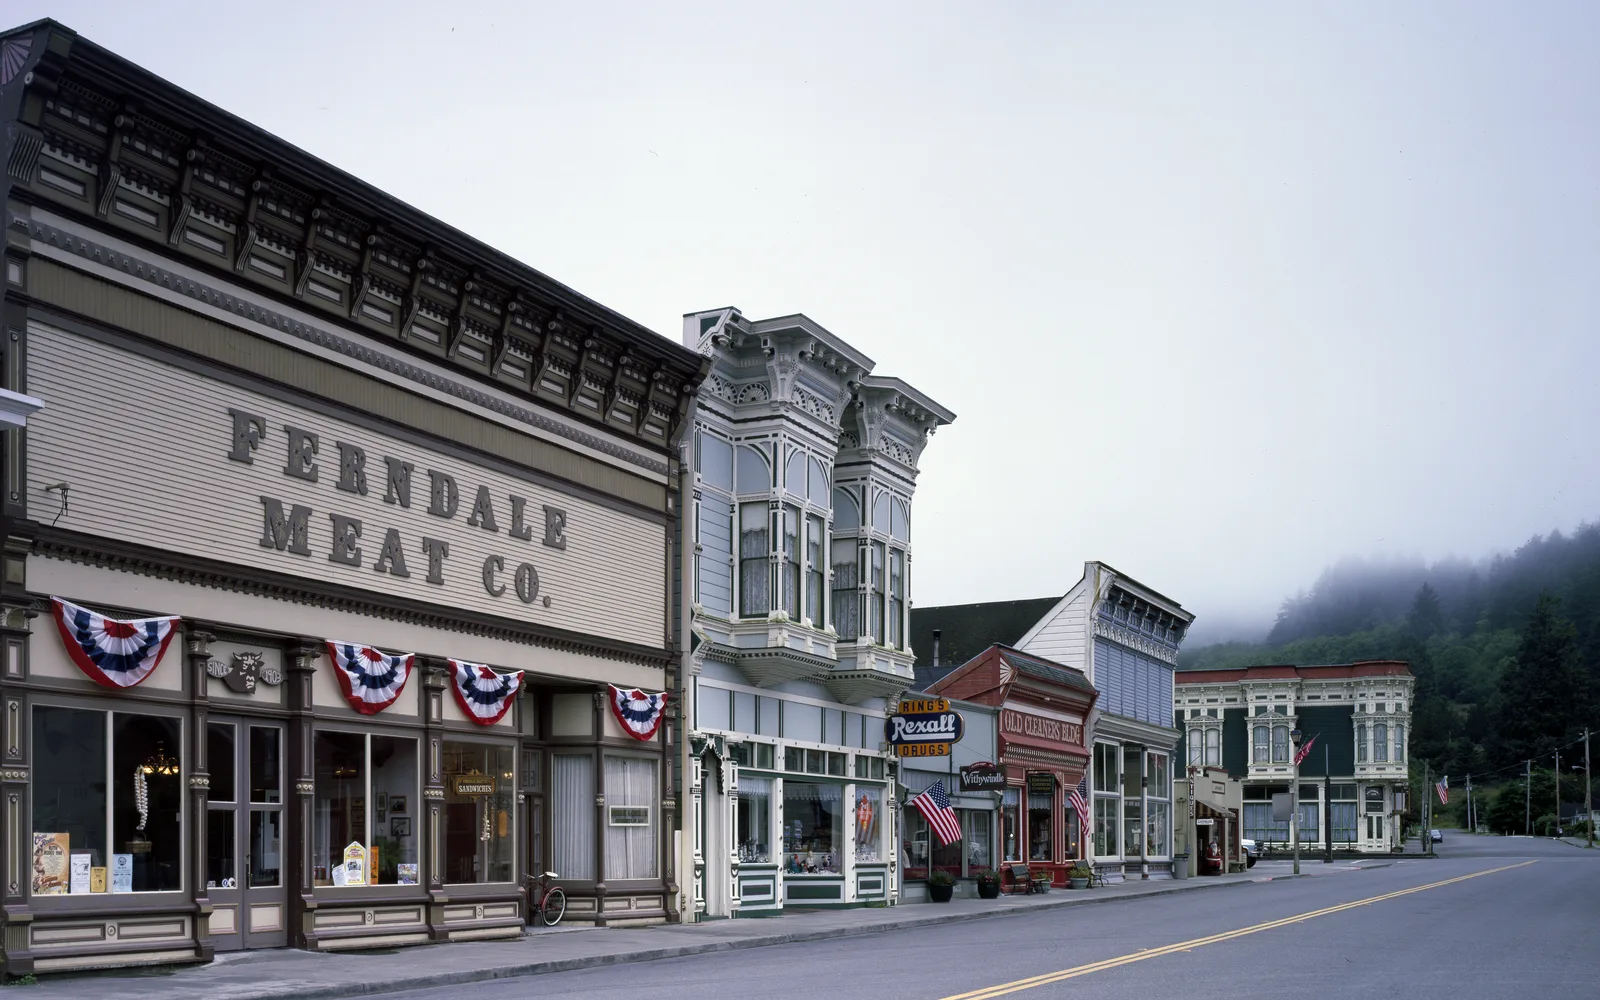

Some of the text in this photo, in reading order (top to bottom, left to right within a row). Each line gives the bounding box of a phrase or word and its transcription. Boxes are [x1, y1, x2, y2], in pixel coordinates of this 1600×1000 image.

[228, 407, 567, 550] FERNDALE
[260, 495, 551, 608] MEAT CO.
[207, 661, 281, 683] SINCE 1903
[903, 701, 945, 712] RING'S
[891, 714, 956, 741] Rexall
[1004, 710, 1080, 745] OLD CLEANERS BLDG
[903, 745, 944, 756] DRUGS
[962, 771, 1004, 786] Withywindle
